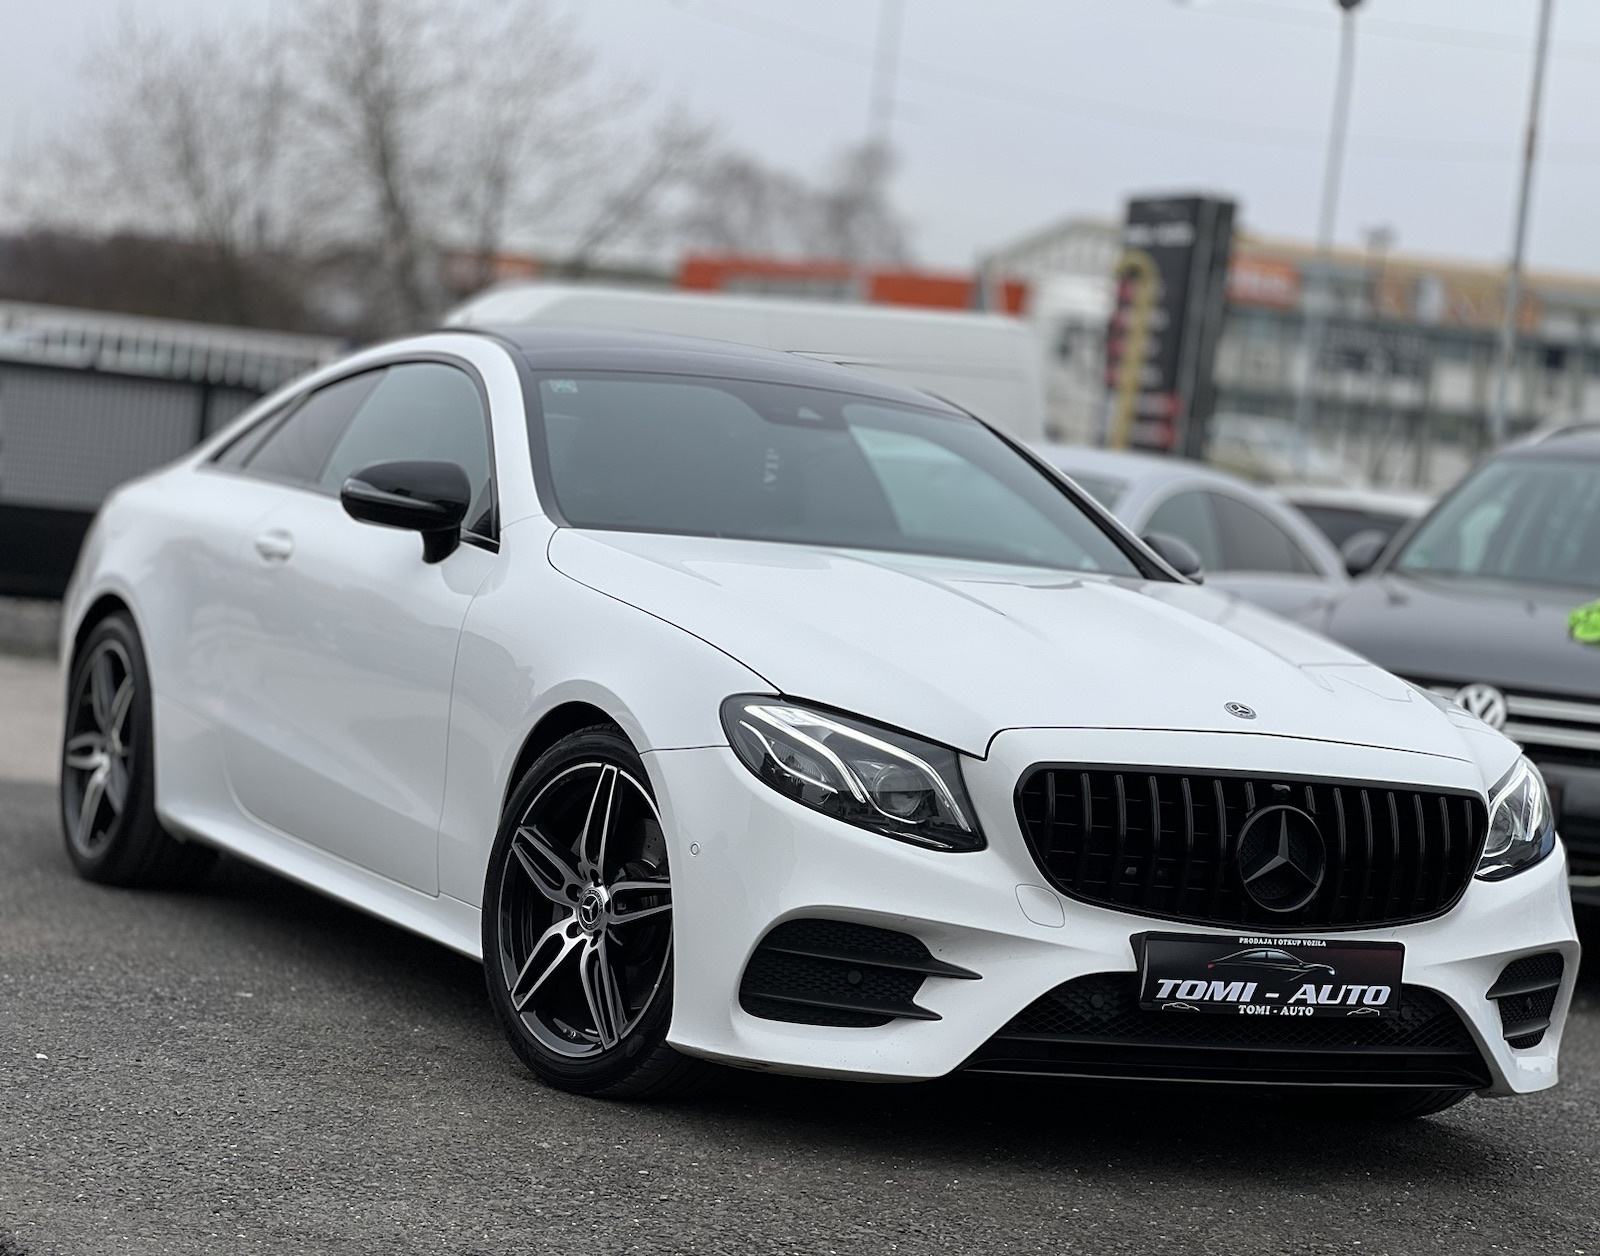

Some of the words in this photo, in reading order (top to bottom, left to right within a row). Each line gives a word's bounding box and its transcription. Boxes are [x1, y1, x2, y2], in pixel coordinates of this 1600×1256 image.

[1239, 937, 1273, 945] PRODAJA
[1278, 938, 1301, 946] OTKUP
[1302, 939, 1327, 947] VOZILA
[1156, 979, 1258, 1002] TOMI
[1288, 984, 1392, 1005] AUTO
[1238, 1004, 1271, 1015] TOMI
[1280, 1006, 1314, 1016] AUTO
